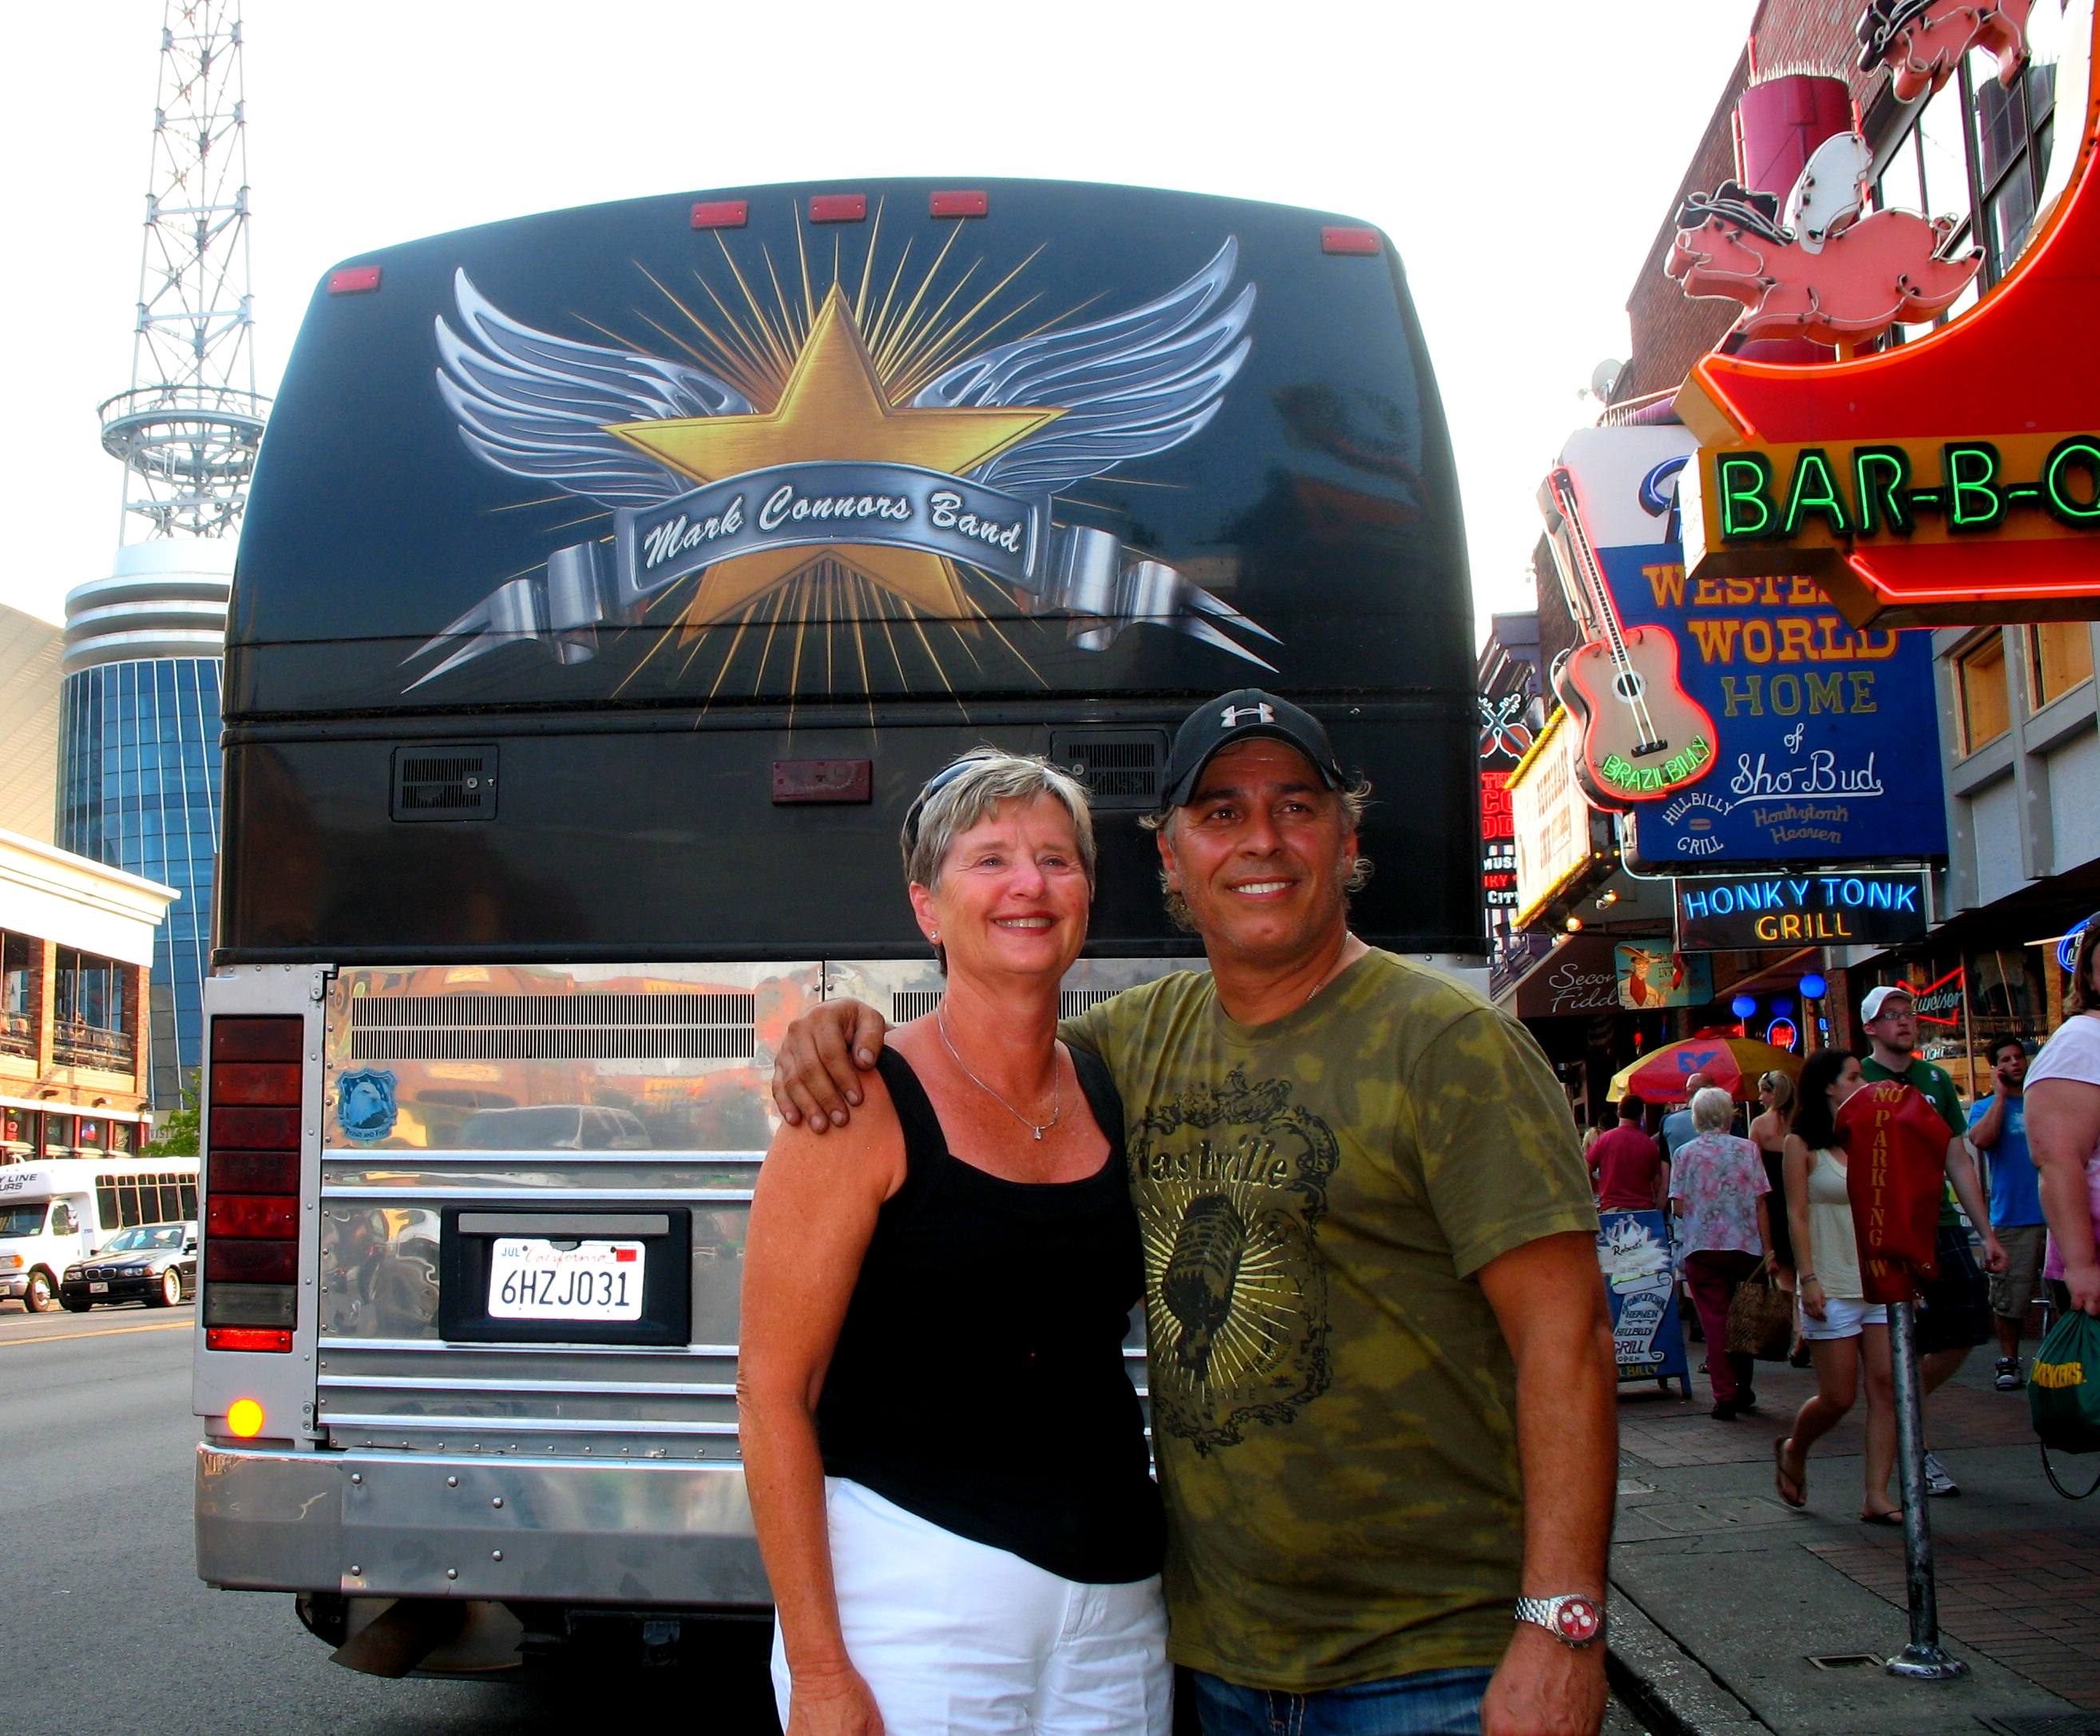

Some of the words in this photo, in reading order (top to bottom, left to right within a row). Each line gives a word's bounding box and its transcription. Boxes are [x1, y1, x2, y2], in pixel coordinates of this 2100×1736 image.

[644, 496, 744, 569] Mark
[758, 485, 911, 531] Connors
[928, 491, 1022, 553] Band
[1642, 564, 1830, 608] WESTE
[1687, 616, 1899, 664] WORLD
[1722, 671, 1878, 717] HOME
[1783, 723, 1804, 754] of
[1730, 750, 1883, 795] Sho-Bud
[1662, 792, 1734, 826] HILLBILLY
[1677, 835, 1724, 855] GRILL
[1483, 856, 1517, 870] MUSI
[1686, 879, 1809, 920] HONKY
[1820, 878, 1917, 913] TONK
[1755, 912, 1852, 941] GRILL
[1551, 987, 1618, 1013] Fidd
[1872, 1087, 1904, 1104] NO
[8, 1173, 38, 1182] LINE
[501, 1247, 520, 1257] JUL
[525, 1247, 615, 1268] California
[501, 1270, 629, 1306] 6HZJ031
